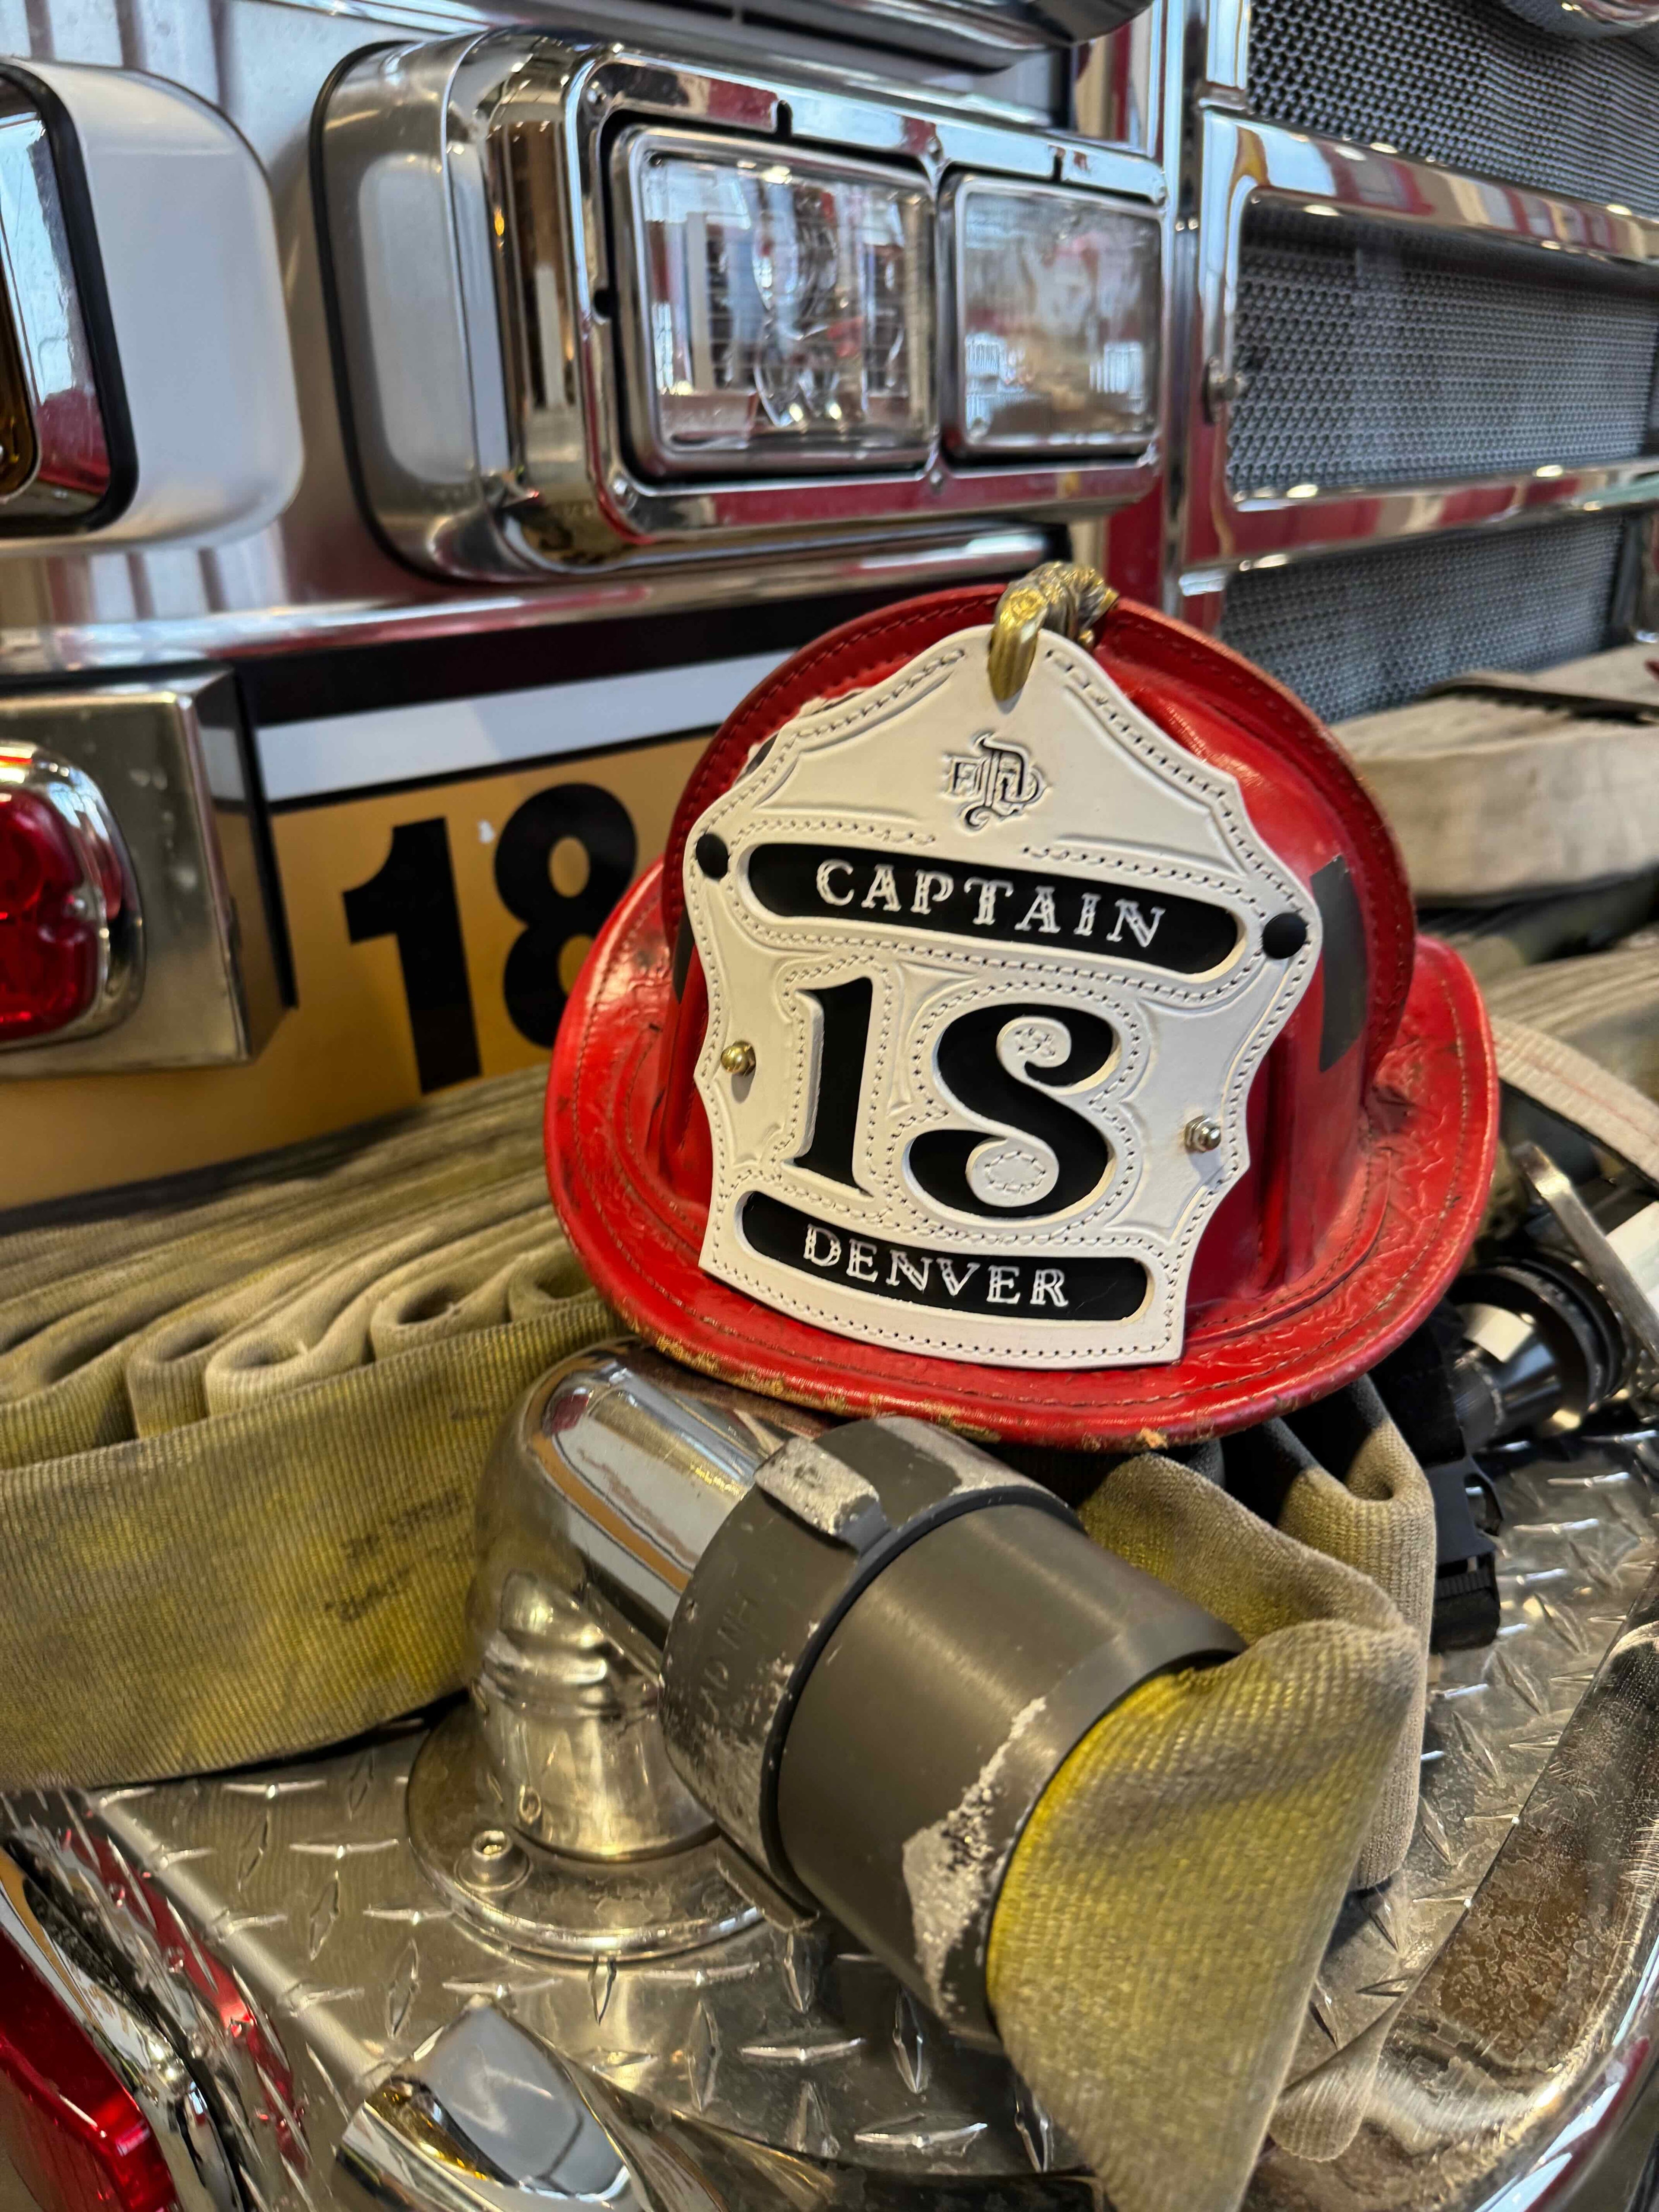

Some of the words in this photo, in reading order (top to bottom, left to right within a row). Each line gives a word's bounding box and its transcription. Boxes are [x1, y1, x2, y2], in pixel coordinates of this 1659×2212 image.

[343, 783, 638, 1096] 18
[816, 860, 1166, 947] CAPTAIN
[792, 976, 1116, 1217] 18
[804, 1224, 1069, 1307] DENVER
